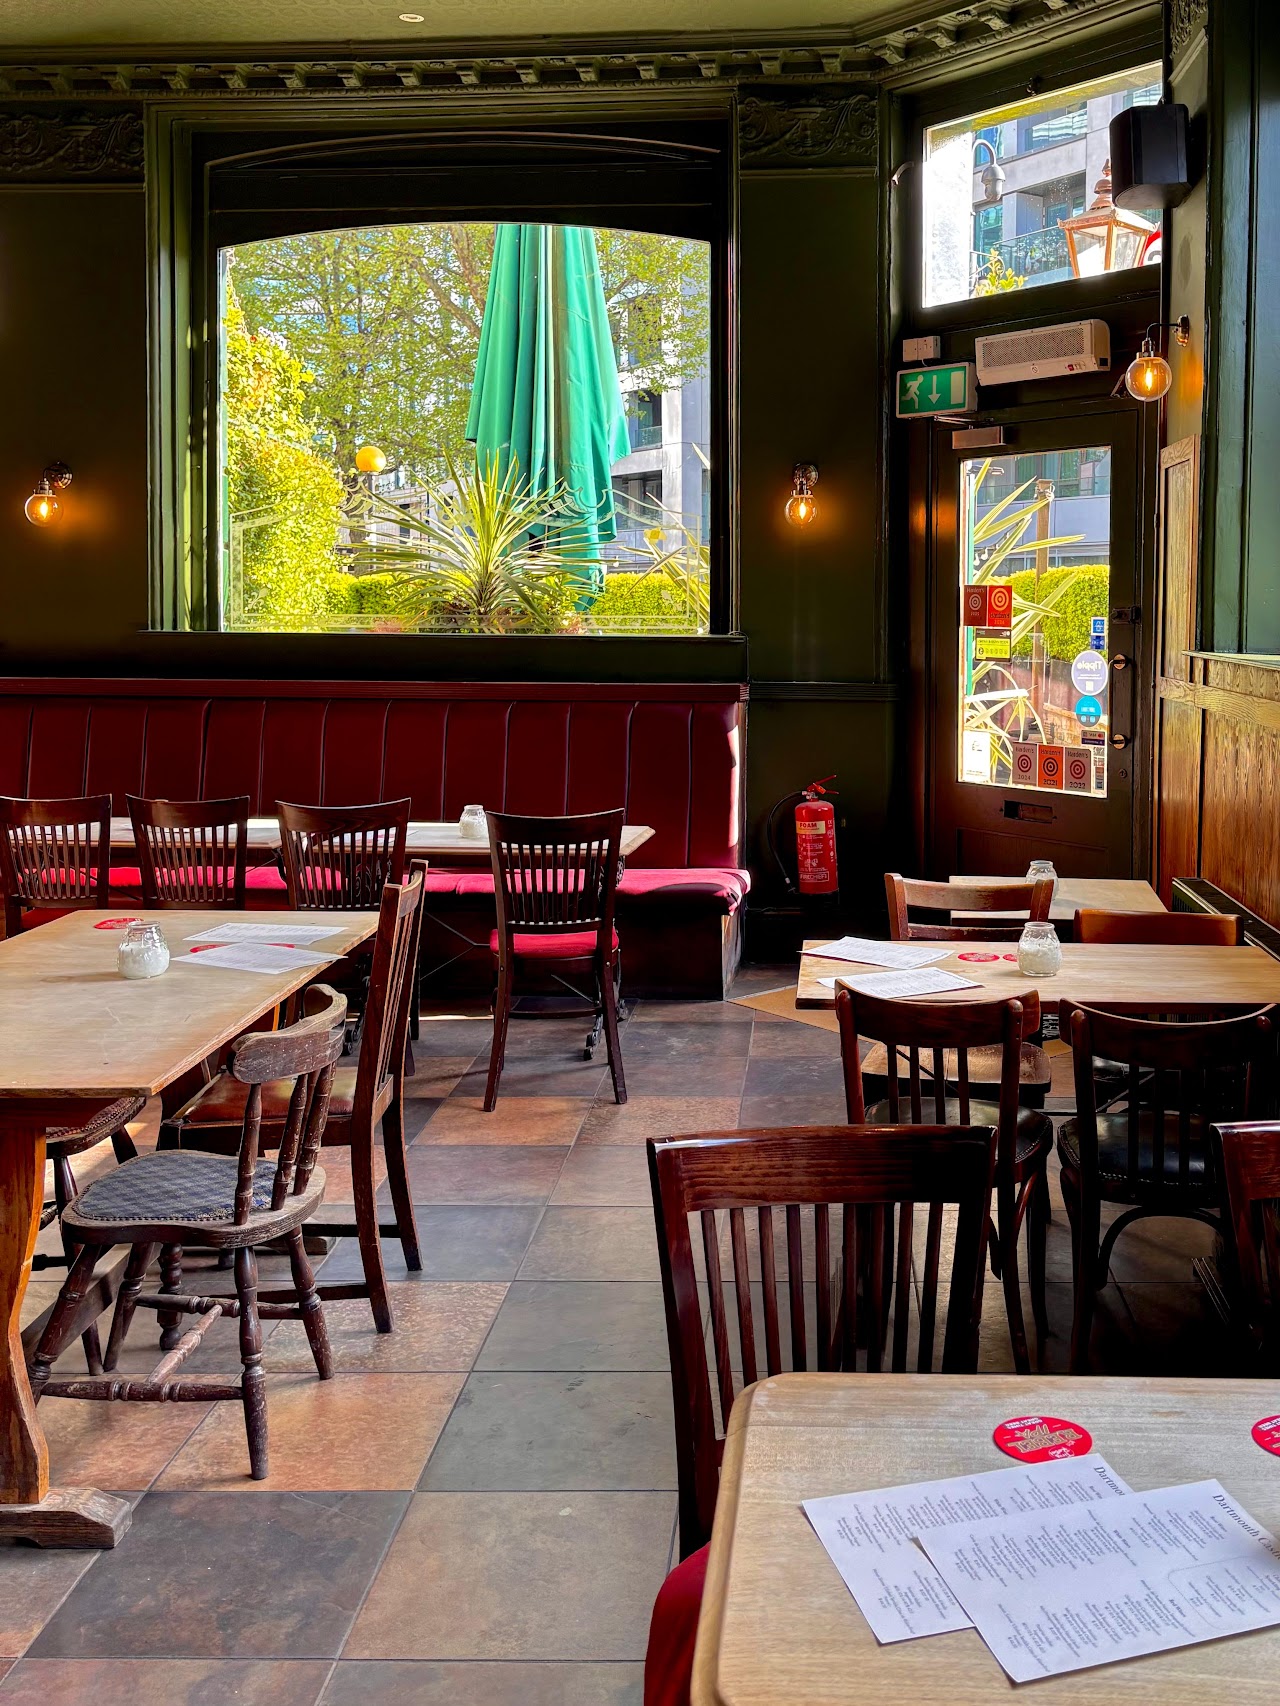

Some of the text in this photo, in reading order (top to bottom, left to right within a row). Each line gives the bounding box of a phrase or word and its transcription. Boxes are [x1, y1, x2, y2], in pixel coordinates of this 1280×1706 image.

[1015, 746, 1035, 754] Harden's
[1040, 748, 1061, 756] Harden's
[1067, 751, 1089, 759] Harden's
[1015, 1424, 1050, 1439] IPA
[1007, 1428, 1083, 1453] REBEL
[1213, 1494, 1260, 1537] Dartmouth
